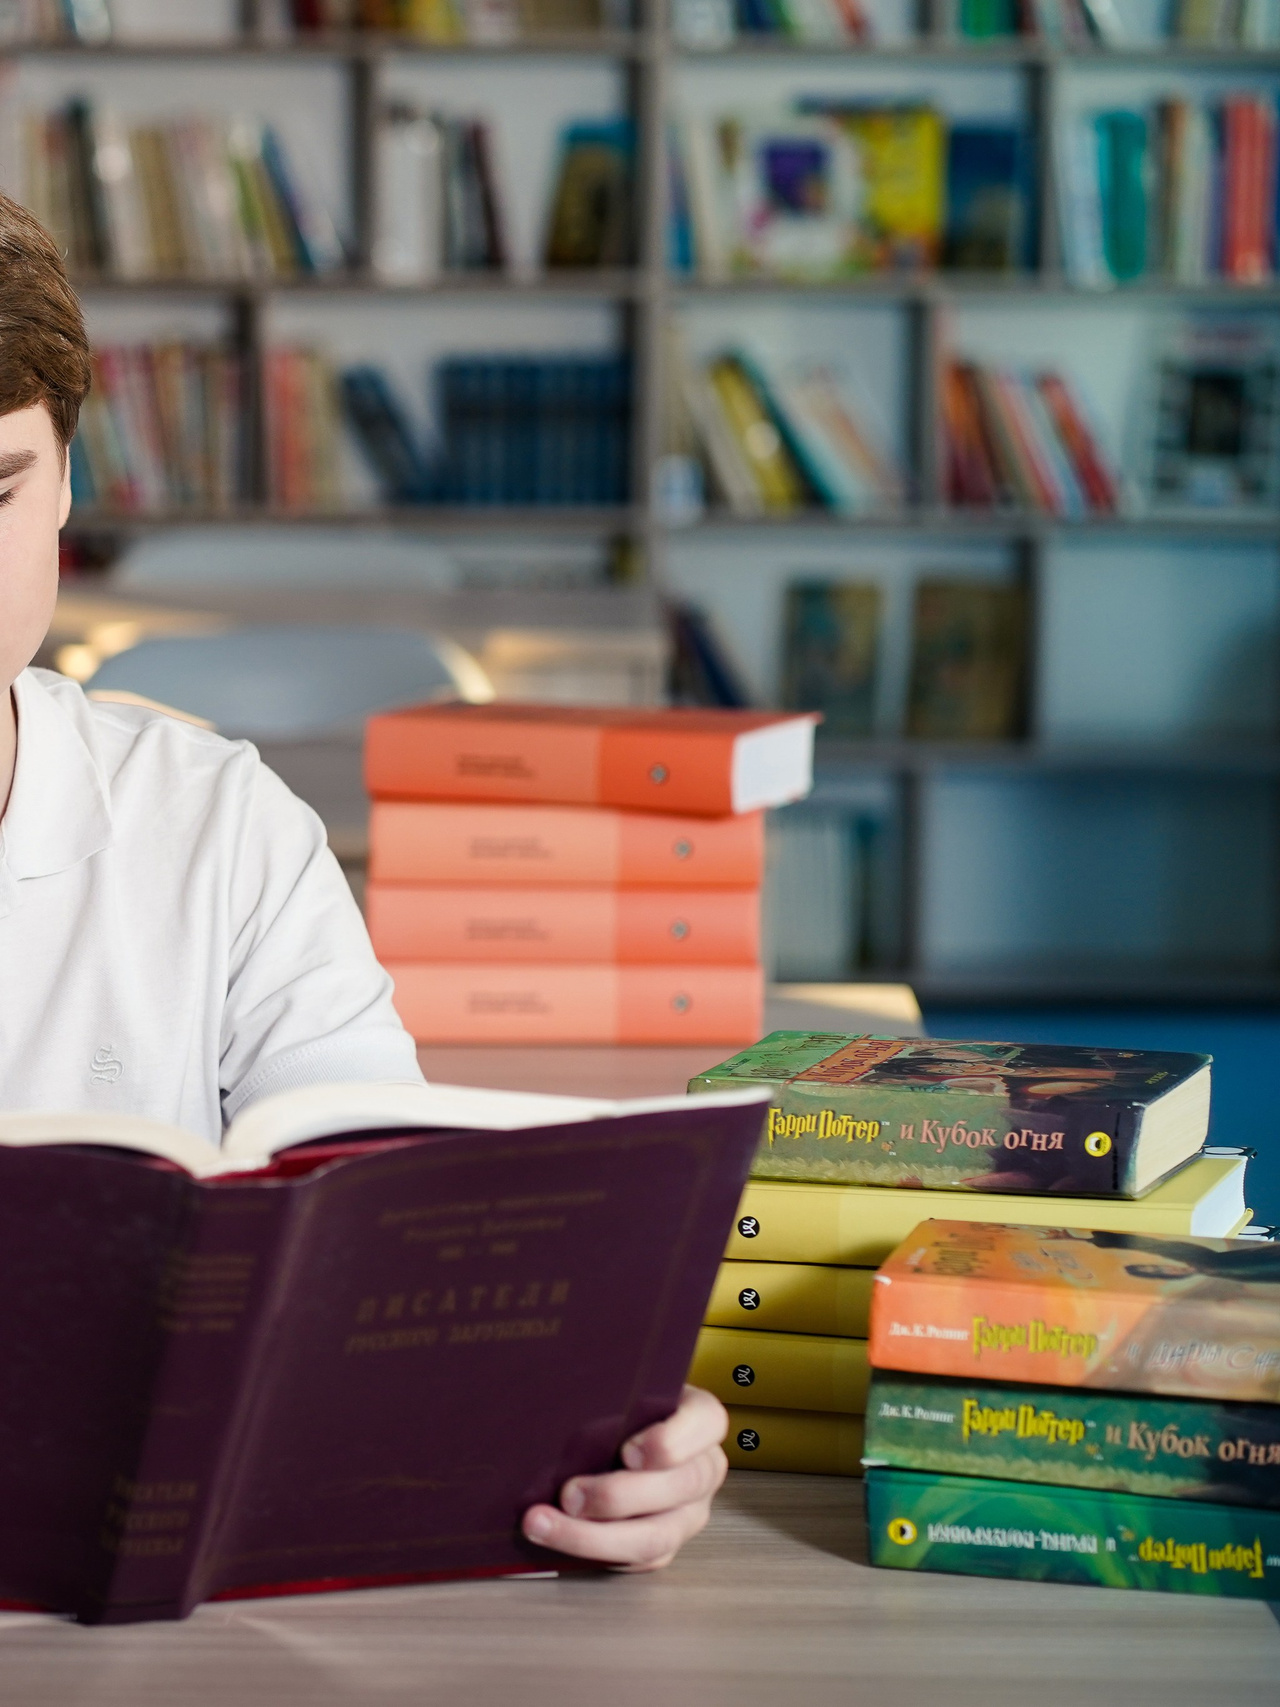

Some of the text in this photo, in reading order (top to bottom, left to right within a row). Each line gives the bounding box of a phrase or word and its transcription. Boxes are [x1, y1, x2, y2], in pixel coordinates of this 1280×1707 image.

[767, 1107, 819, 1150] Гарри
[817, 1109, 881, 1145] Поттер
[900, 1123, 914, 1141] и
[920, 1119, 998, 1154] Кубок
[1003, 1128, 1065, 1152] огня
[972, 1316, 1027, 1358] Гарри
[1028, 1320, 1098, 1359] Поттер
[962, 1398, 1018, 1443] Гарри
[1016, 1404, 1086, 1446] Поттер
[1105, 1424, 1122, 1444] и
[1128, 1421, 1211, 1461] Кубок
[1218, 1438, 1280, 1465] огня
[1138, 1535, 1208, 1574] Поттер
[1208, 1534, 1264, 1578] Гарри
